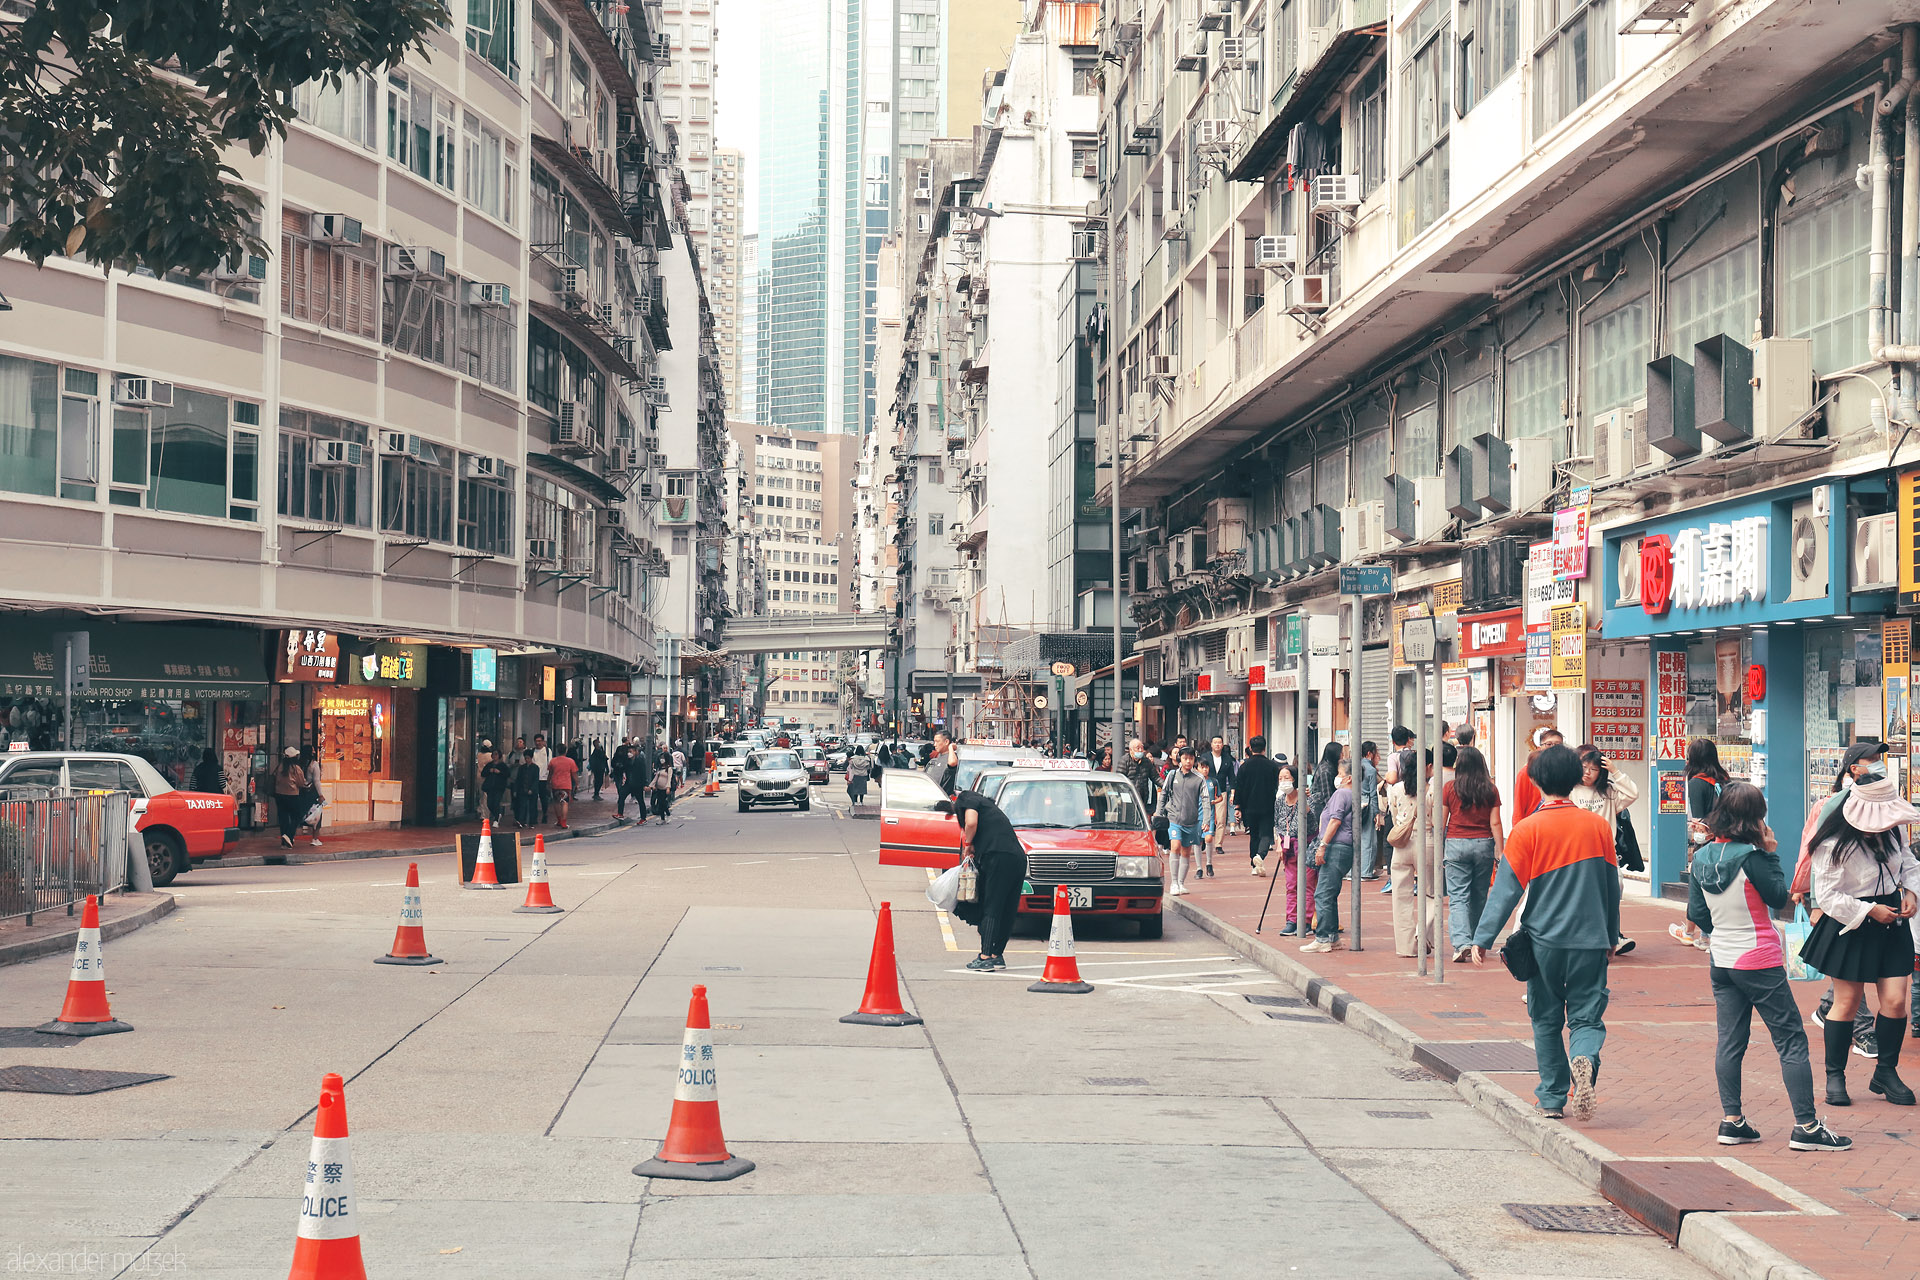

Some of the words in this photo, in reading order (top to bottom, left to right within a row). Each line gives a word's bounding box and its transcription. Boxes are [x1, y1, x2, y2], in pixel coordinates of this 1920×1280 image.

[1669, 516, 1767, 610] 利嘉閣
[1480, 623, 1507, 644] COMEBUY
[1658, 652, 1686, 672] 把握
[1595, 681, 1640, 691] 天后物業
[1658, 673, 1686, 694] 樓市
[100, 688, 113, 696] PRO
[115, 688, 133, 697] SHOP
[195, 689, 220, 698] VICTORIA
[1595, 708, 1617, 716] 2566
[1620, 708, 1641, 716] 3121
[1595, 724, 1640, 733] 天后物業
[1658, 717, 1686, 738] 低位
[1619, 751, 1640, 759] 3121
[1658, 739, 1686, 759] 入貨
[1049, 760, 1085, 768] TAXI
[185, 799, 205, 809] TAXI
[206, 799, 223, 809] 的士
[1069, 897, 1088, 906] 712
[684, 1044, 712, 1061] 警察
[306, 1161, 342, 1184] 警察
[302, 1196, 348, 1217] OLICE
